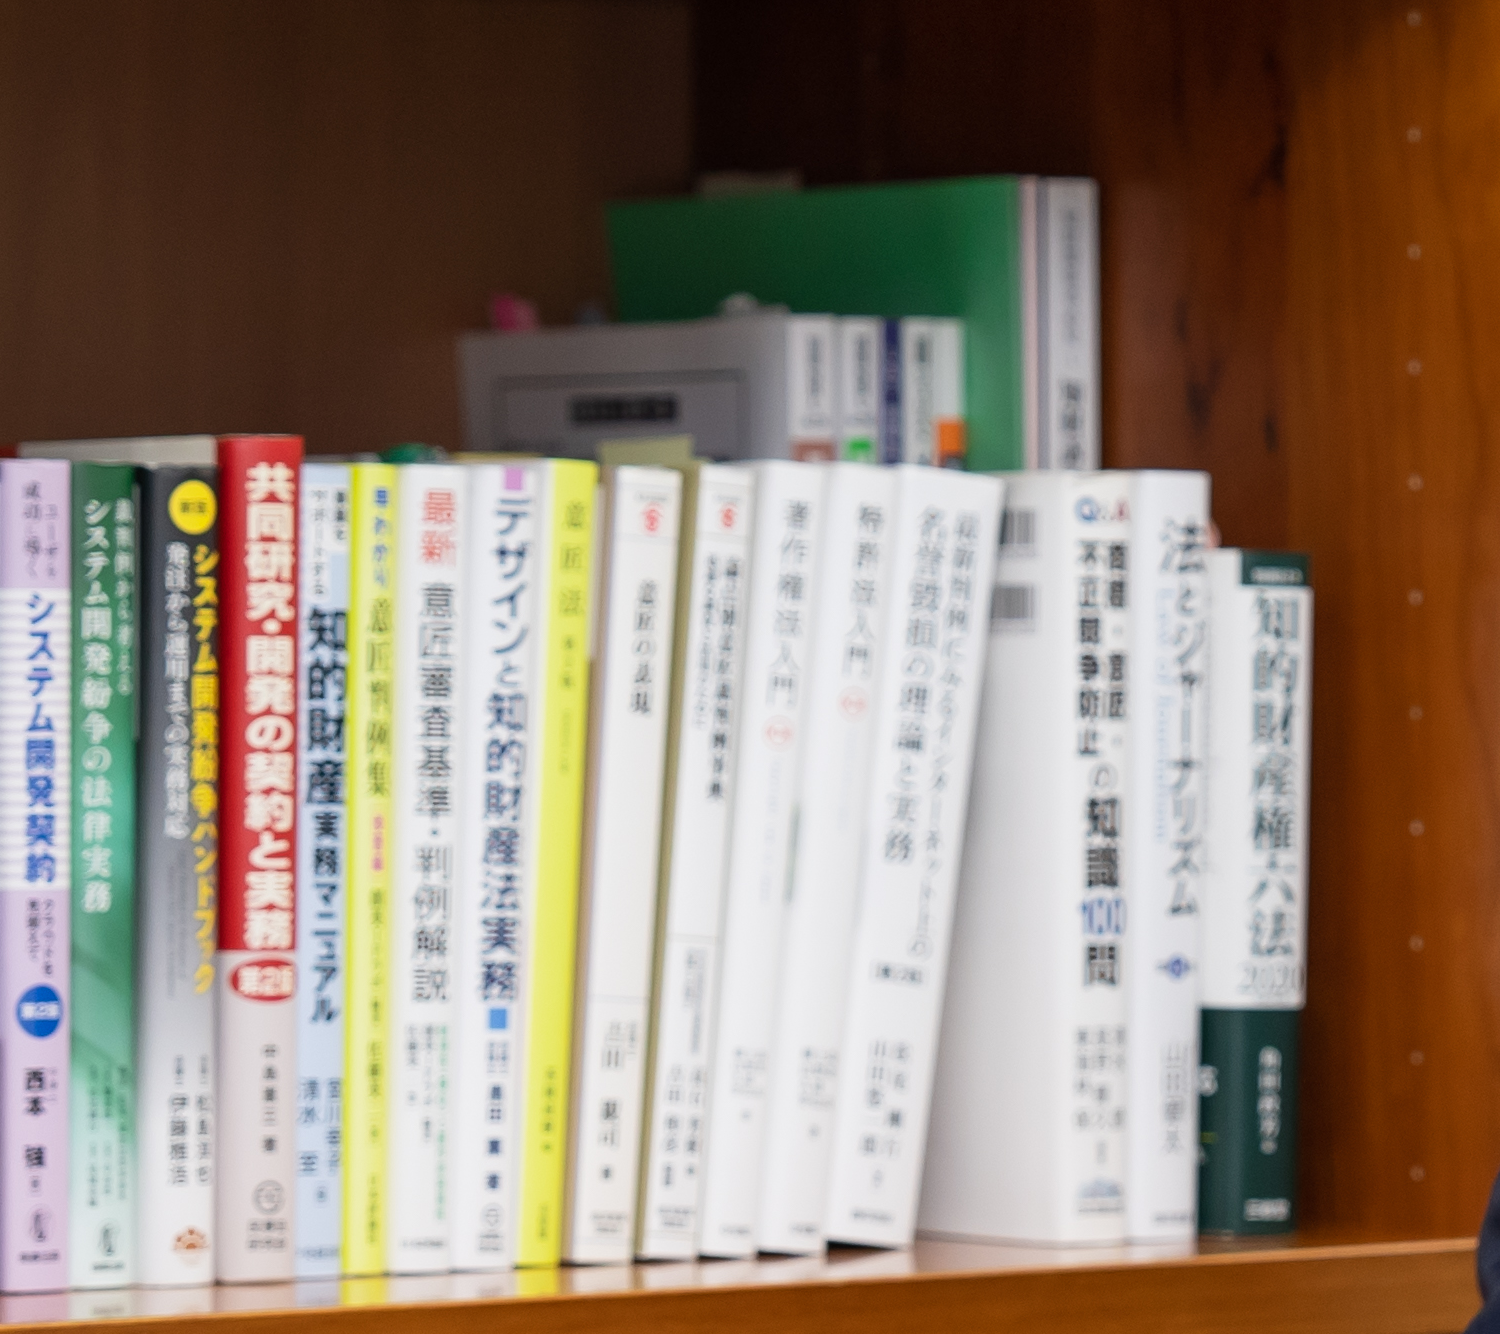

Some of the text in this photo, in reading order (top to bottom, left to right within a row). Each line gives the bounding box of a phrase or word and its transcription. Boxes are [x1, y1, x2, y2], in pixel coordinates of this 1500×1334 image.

[80, 499, 113, 914] システム開発紛争の法律実務
[244, 462, 296, 950] 共同研究・開発の契約と実務
[421, 487, 457, 565] 最新
[766, 500, 810, 708] 著作権法入門
[841, 503, 883, 678] 特許法入門
[885, 505, 945, 864] 名誉毀損の理論と実務
[1076, 540, 1101, 757] 不正競争防止
[25, 593, 57, 884] システム開発契約
[305, 607, 349, 1024] 知的財産実務マニュアル
[413, 581, 456, 1002] 意匠審査基準・判例解説
[1160, 517, 1207, 916] 法とジャーナリズム
[1251, 589, 1299, 957] 知的財産権六法
